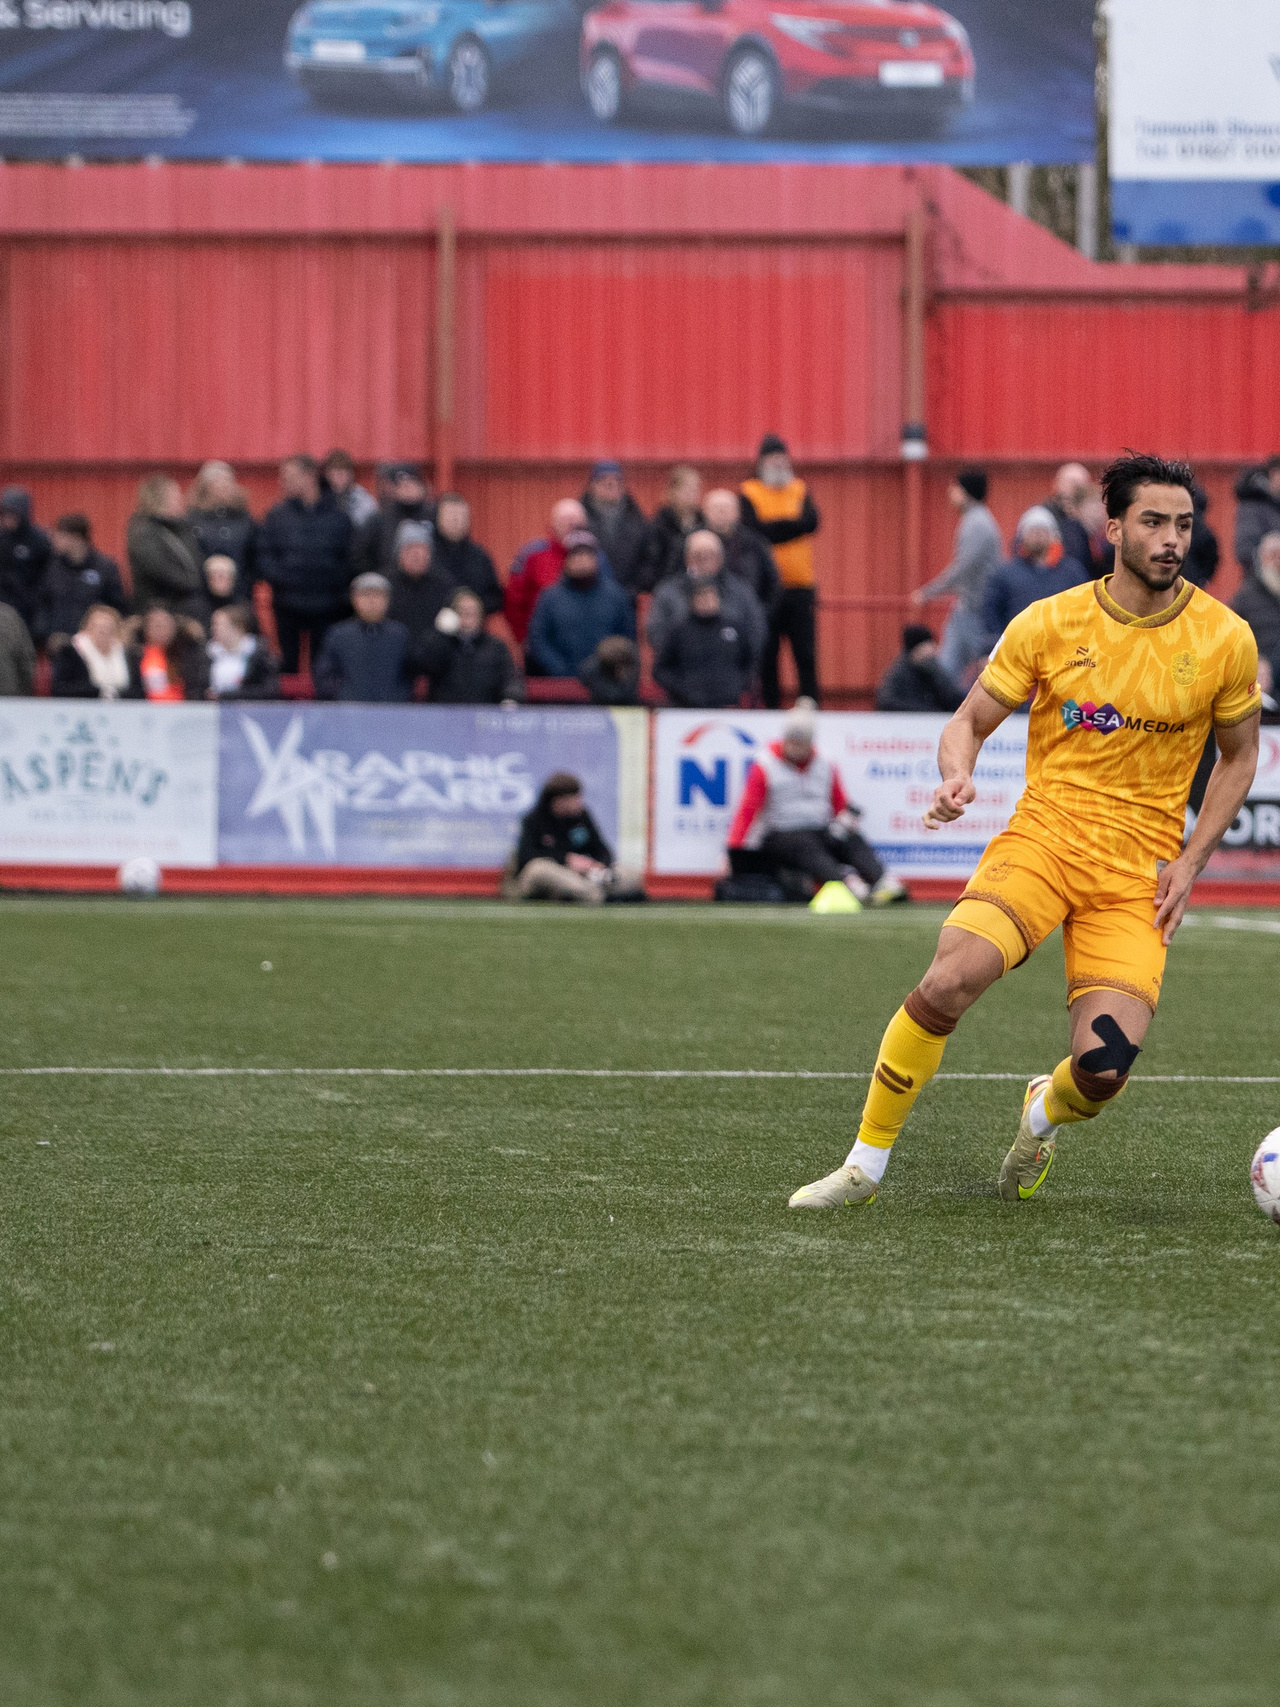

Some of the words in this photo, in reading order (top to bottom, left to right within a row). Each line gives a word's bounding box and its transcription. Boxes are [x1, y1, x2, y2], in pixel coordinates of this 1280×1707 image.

[23, 0, 193, 38] Servicing
[1064, 657, 1097, 668] oneills
[1061, 704, 1121, 728] TELSA
[1124, 715, 1187, 734] MEDIA
